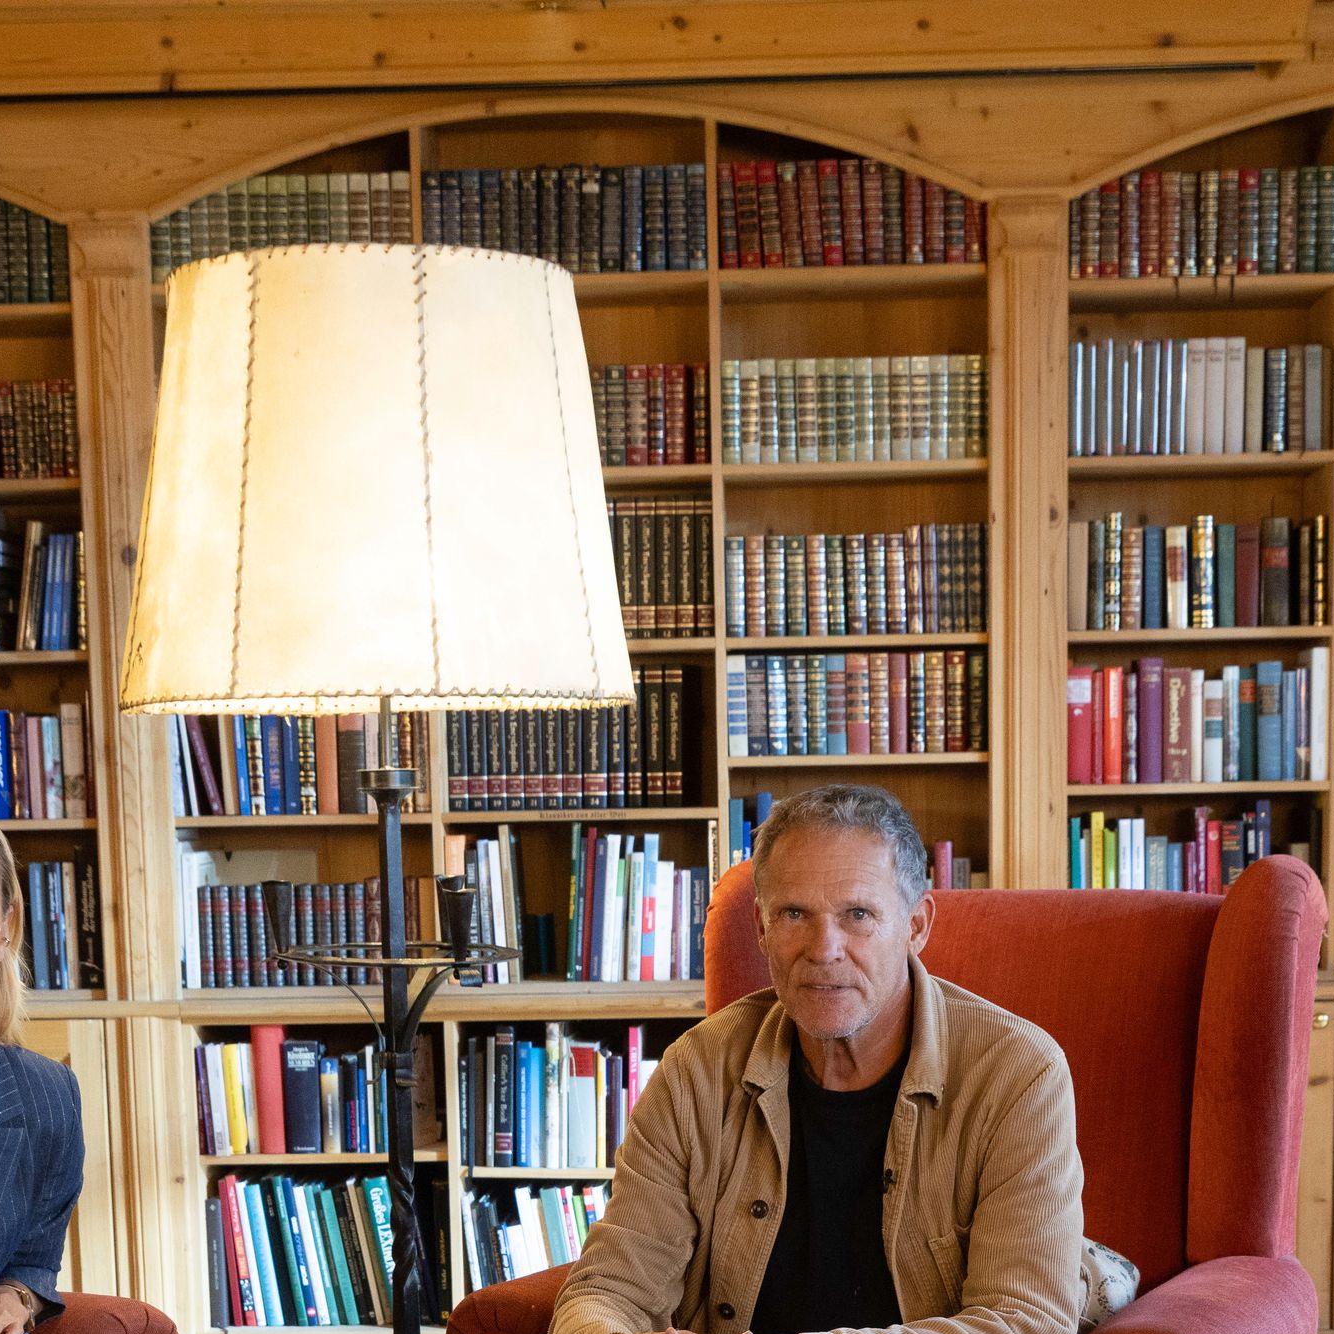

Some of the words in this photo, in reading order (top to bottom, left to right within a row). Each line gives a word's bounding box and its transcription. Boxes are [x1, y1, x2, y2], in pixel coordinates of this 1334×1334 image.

[622, 517, 631, 550] Collier's
[641, 517, 650, 550] Collier's
[661, 517, 670, 550] Collier's
[681, 516, 690, 549] Collier's
[701, 516, 709, 548] Collier's
[621, 552, 631, 604] Encyclopedia
[641, 551, 650, 604] Encyclopedia
[661, 551, 670, 603] Encyclopedia
[680, 550, 690, 602] Encyclopedia
[699, 550, 709, 602] Encyclopedia
[650, 693, 658, 721] Collier's
[669, 692, 678, 721] Collier's
[1169, 677, 1181, 744] Detective
[451, 723, 461, 774] Encyclopedia
[471, 722, 481, 773] Encyclopedia
[489, 722, 499, 773] Encyclopedia
[508, 721, 519, 772] Encyclopedia
[526, 721, 536, 772] Encyclopedia
[546, 721, 556, 772] Encyclopedia
[566, 721, 576, 772] Encyclopedia
[588, 720, 598, 770] Encyclopedia
[612, 743, 620, 763] Book
[629, 743, 637, 763] Book
[649, 722, 659, 761] Dictionary
[668, 722, 679, 761] Dictionary
[269, 768, 281, 789] SALT
[499, 1054, 509, 1085] Collier's
[499, 1086, 508, 1101] Year
[499, 1103, 508, 1124] Book
[369, 1188, 387, 1224] Großes
